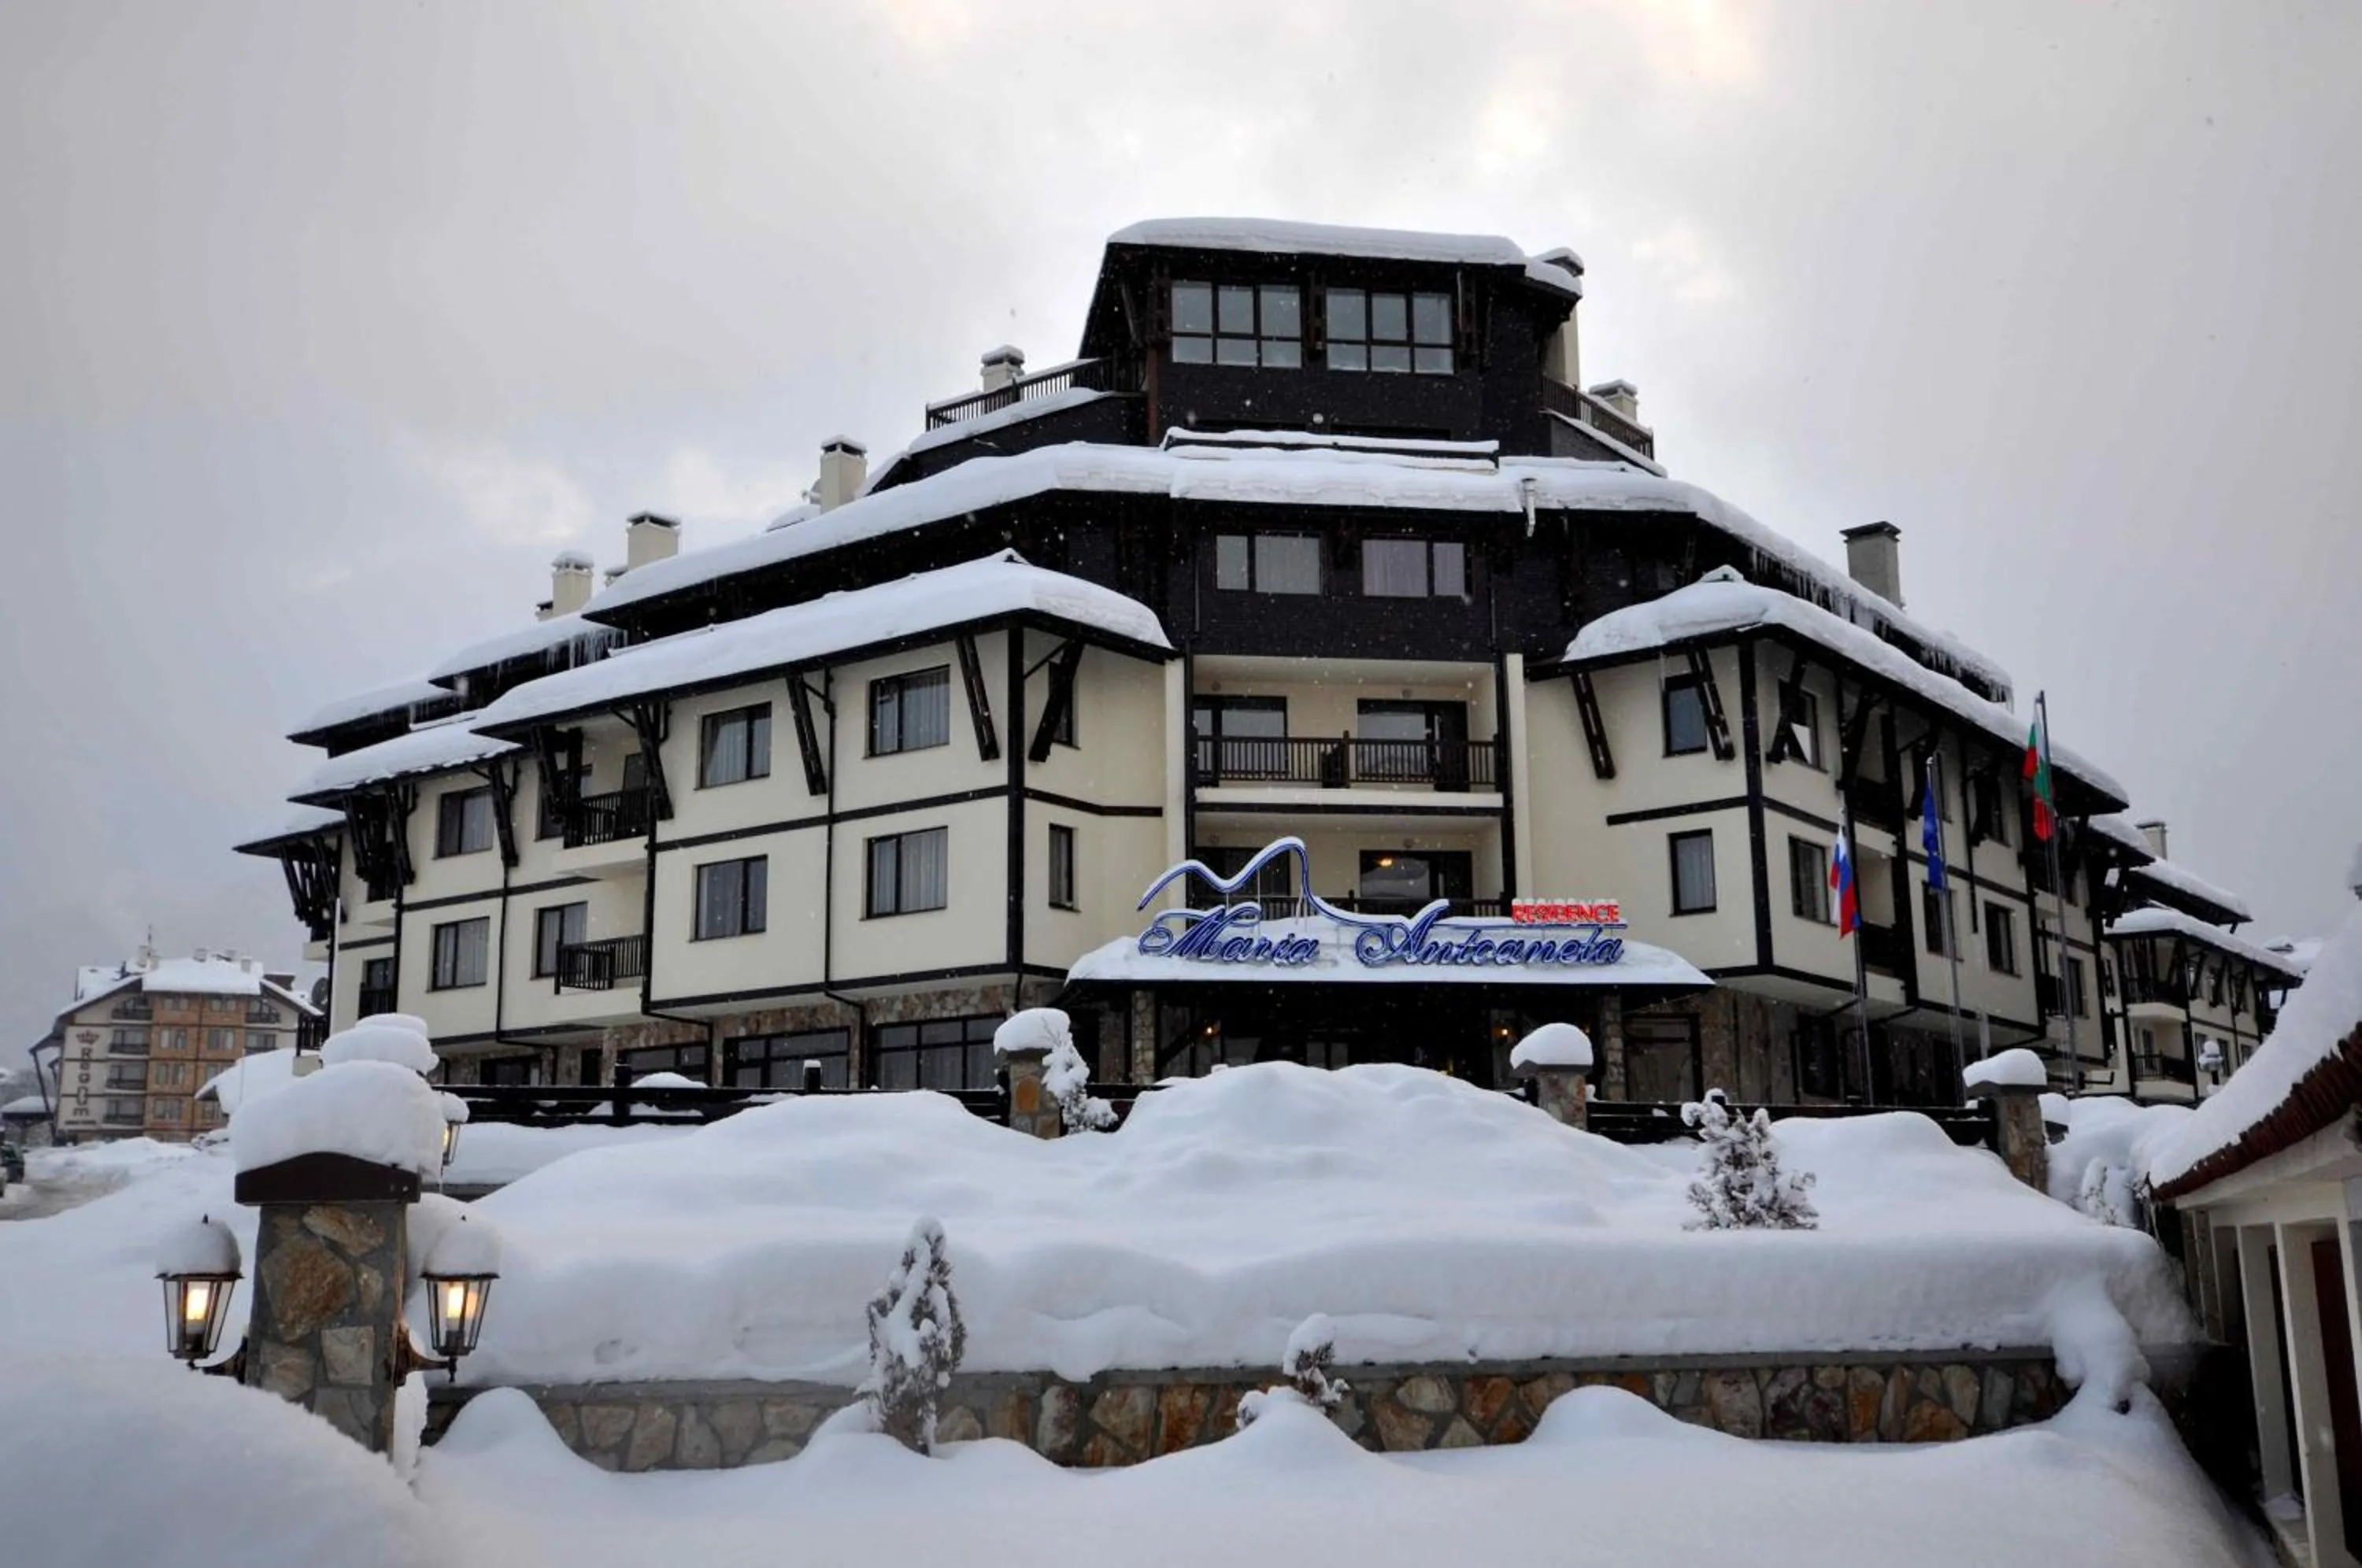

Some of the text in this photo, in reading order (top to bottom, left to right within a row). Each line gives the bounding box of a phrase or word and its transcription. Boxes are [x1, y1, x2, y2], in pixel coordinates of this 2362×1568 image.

[1512, 902, 1620, 923] RESIDENCE
[1138, 902, 1625, 967] Maria Antoaneta
